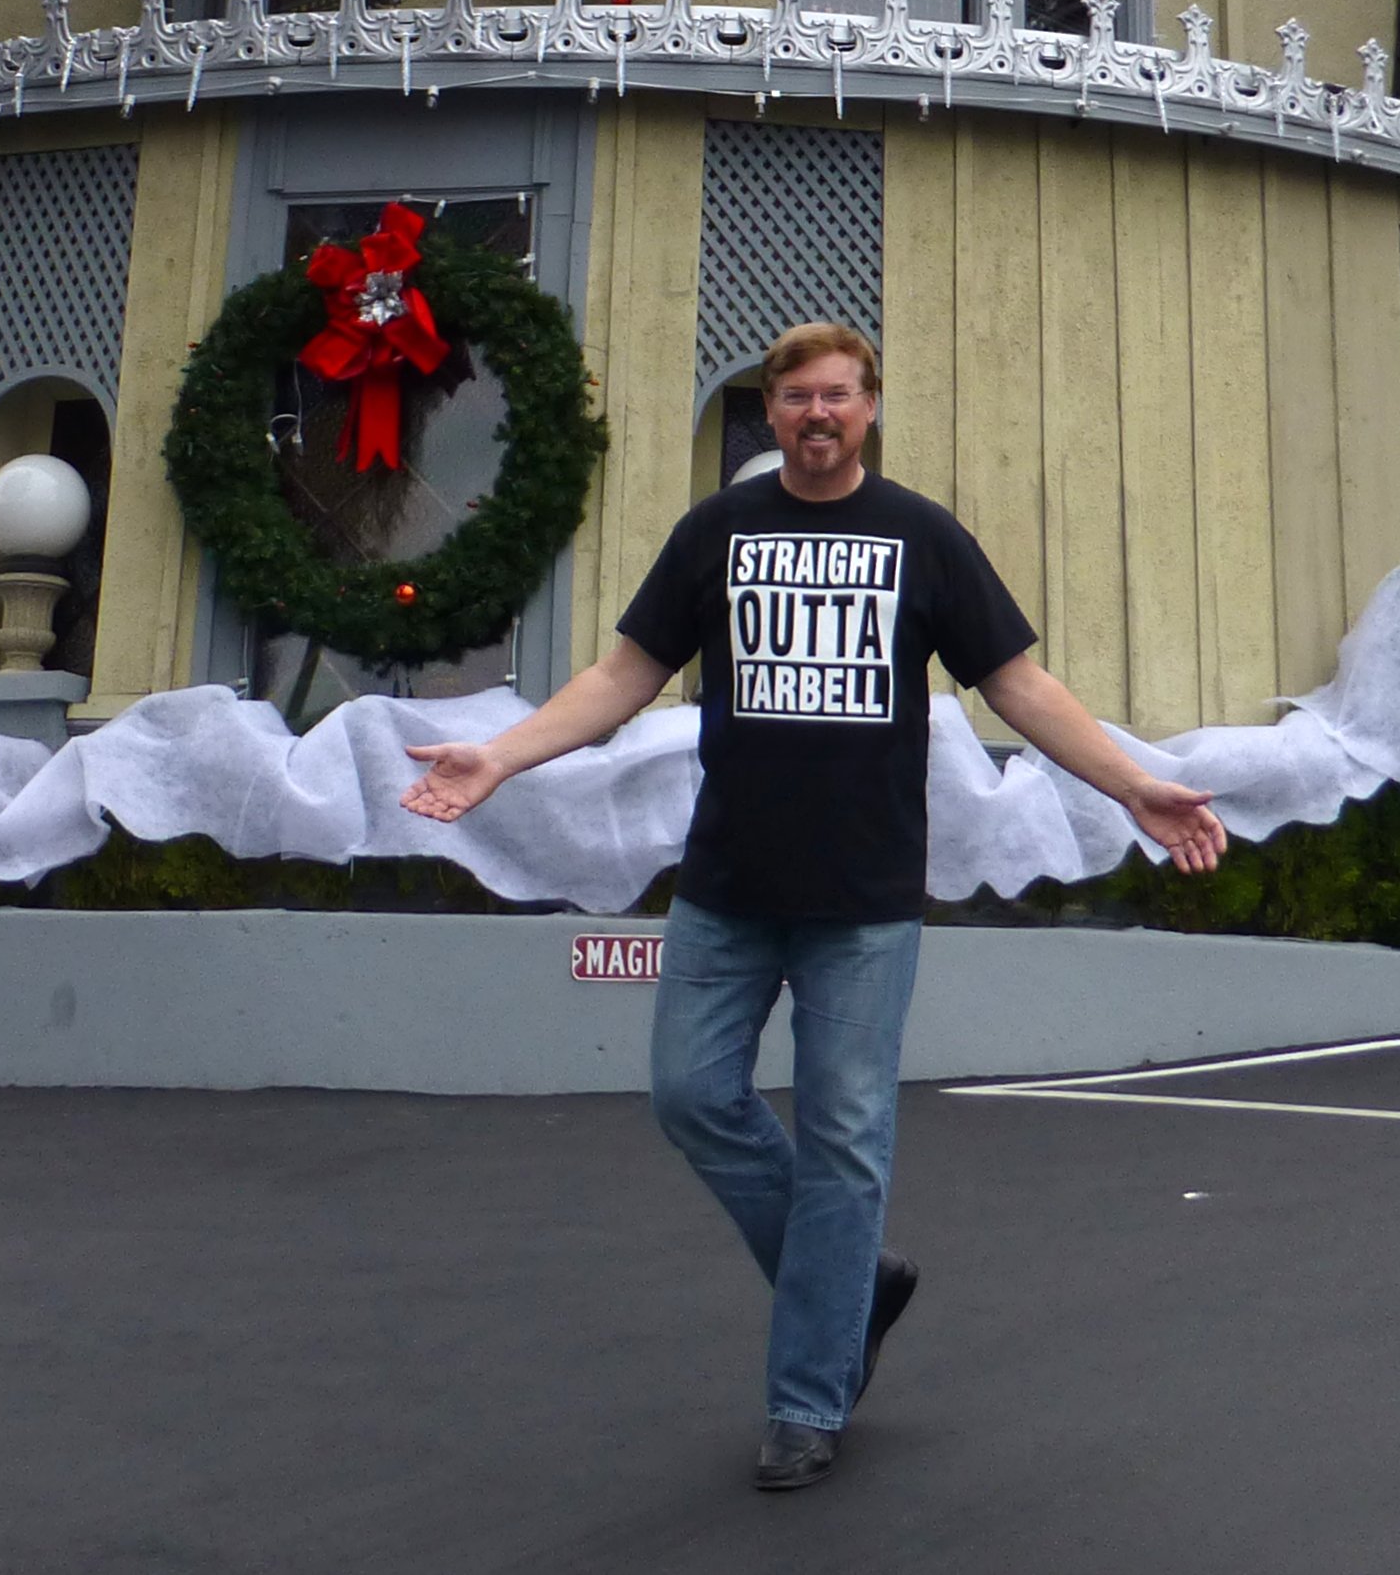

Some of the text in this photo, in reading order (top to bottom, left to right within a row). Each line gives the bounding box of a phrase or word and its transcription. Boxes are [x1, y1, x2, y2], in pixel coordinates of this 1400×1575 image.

[736, 540, 892, 586] STRAIGHT
[737, 589, 883, 659] OUTTA
[740, 663, 883, 714] TARBELL
